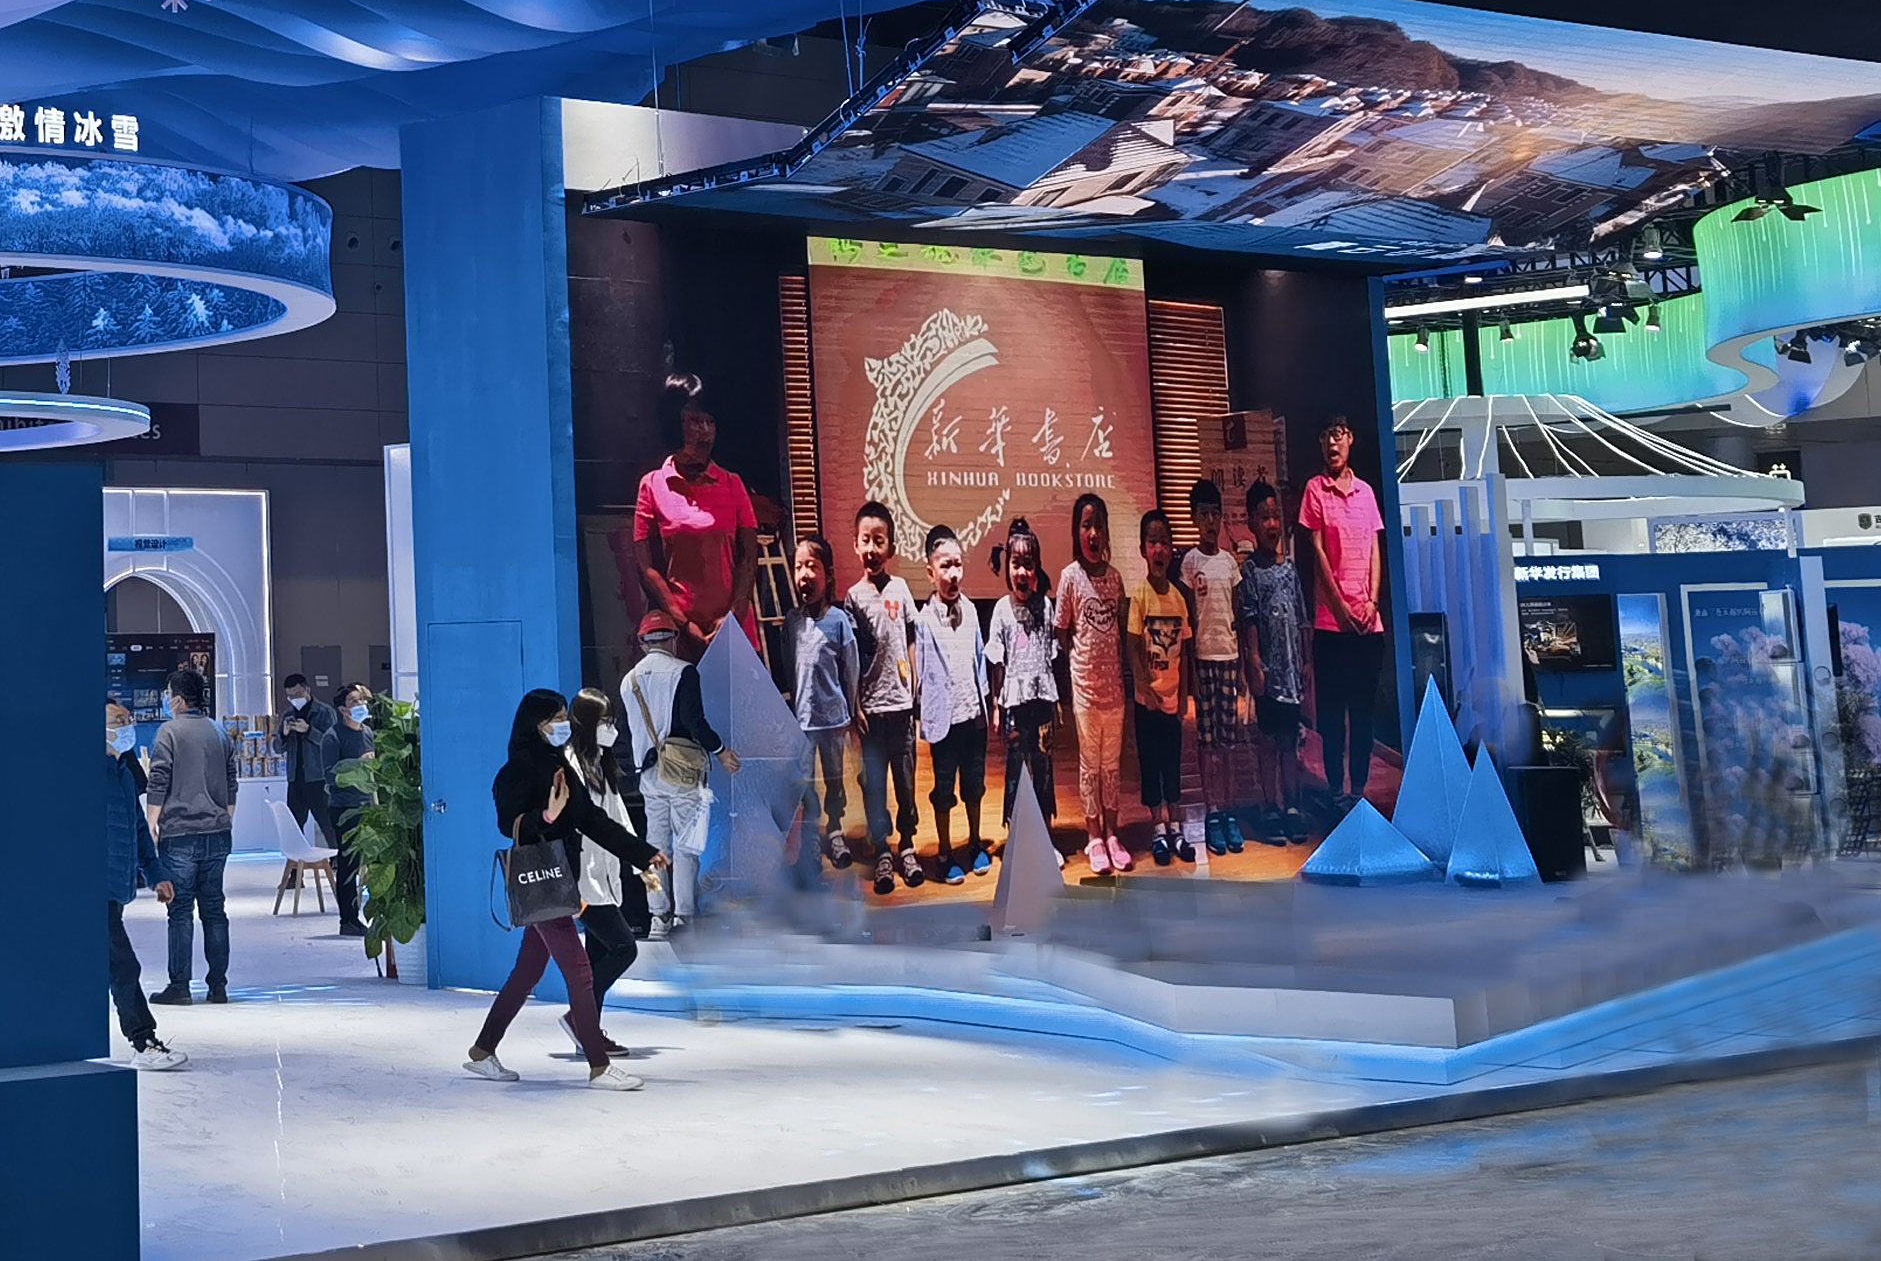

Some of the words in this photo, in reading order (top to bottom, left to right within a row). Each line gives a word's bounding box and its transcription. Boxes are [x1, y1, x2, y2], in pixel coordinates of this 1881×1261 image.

[926, 470, 1000, 488] XINHUA
[1015, 472, 1117, 490] BOOKSTORE
[518, 866, 563, 885] CELINE
